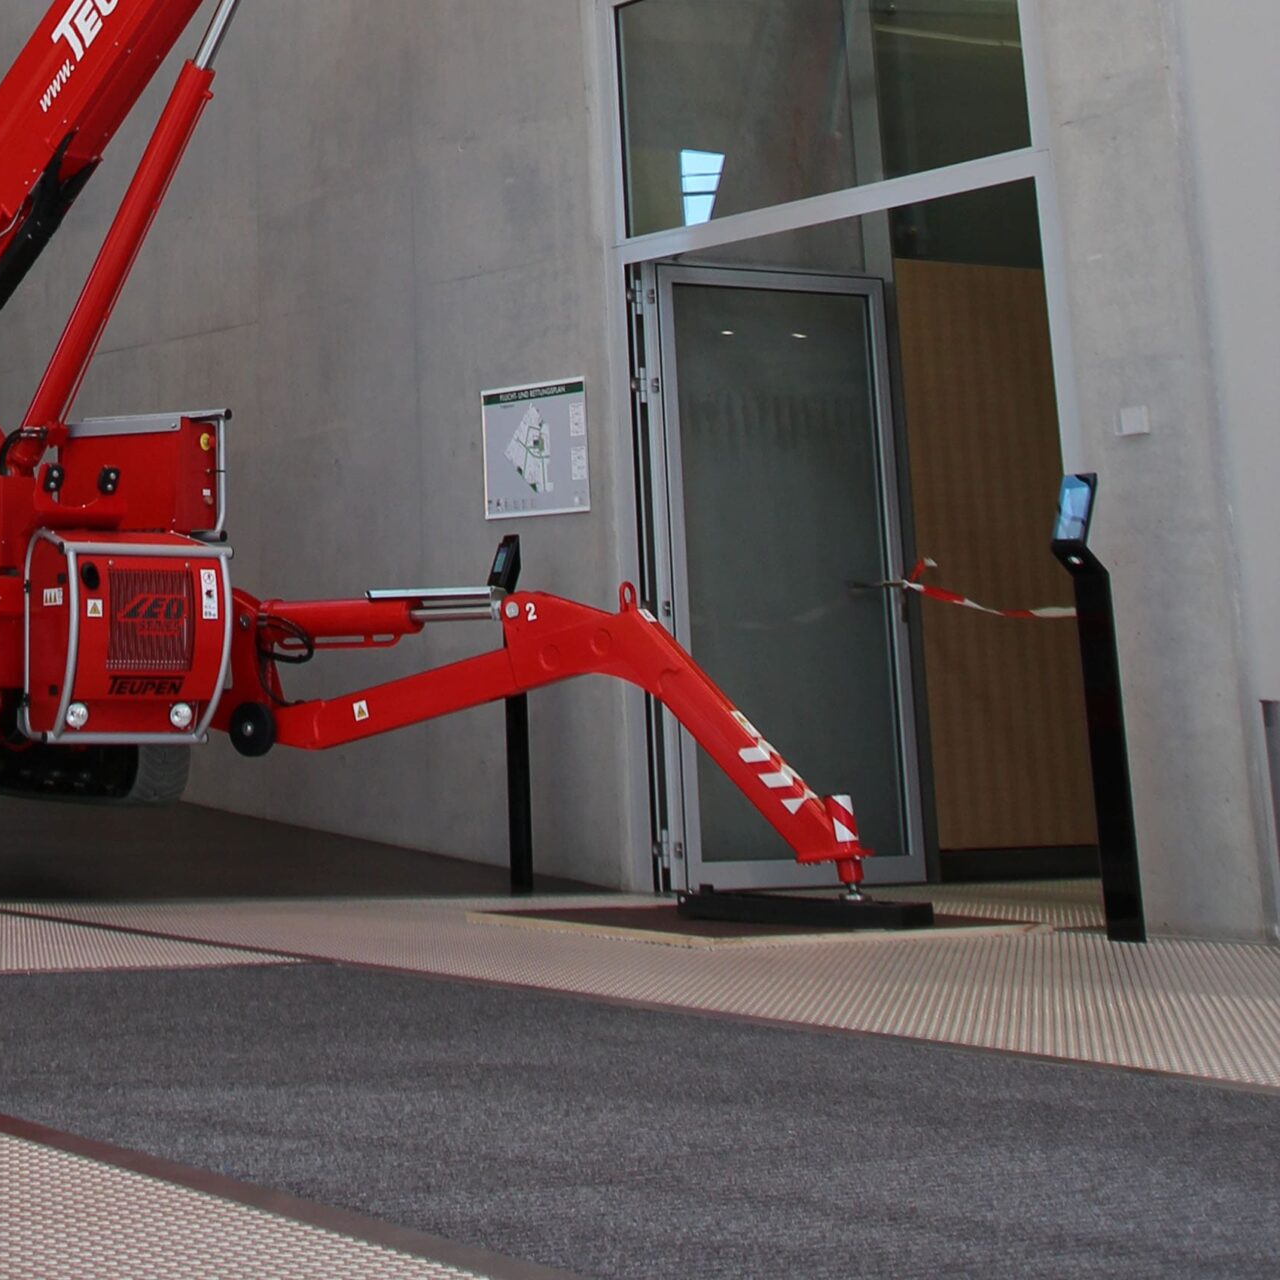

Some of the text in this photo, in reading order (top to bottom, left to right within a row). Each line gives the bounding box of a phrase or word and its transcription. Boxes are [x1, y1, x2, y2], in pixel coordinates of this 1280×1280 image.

[124, 597, 184, 620] LEO
[525, 602, 538, 622] 2
[108, 675, 186, 695] TEUPEN
